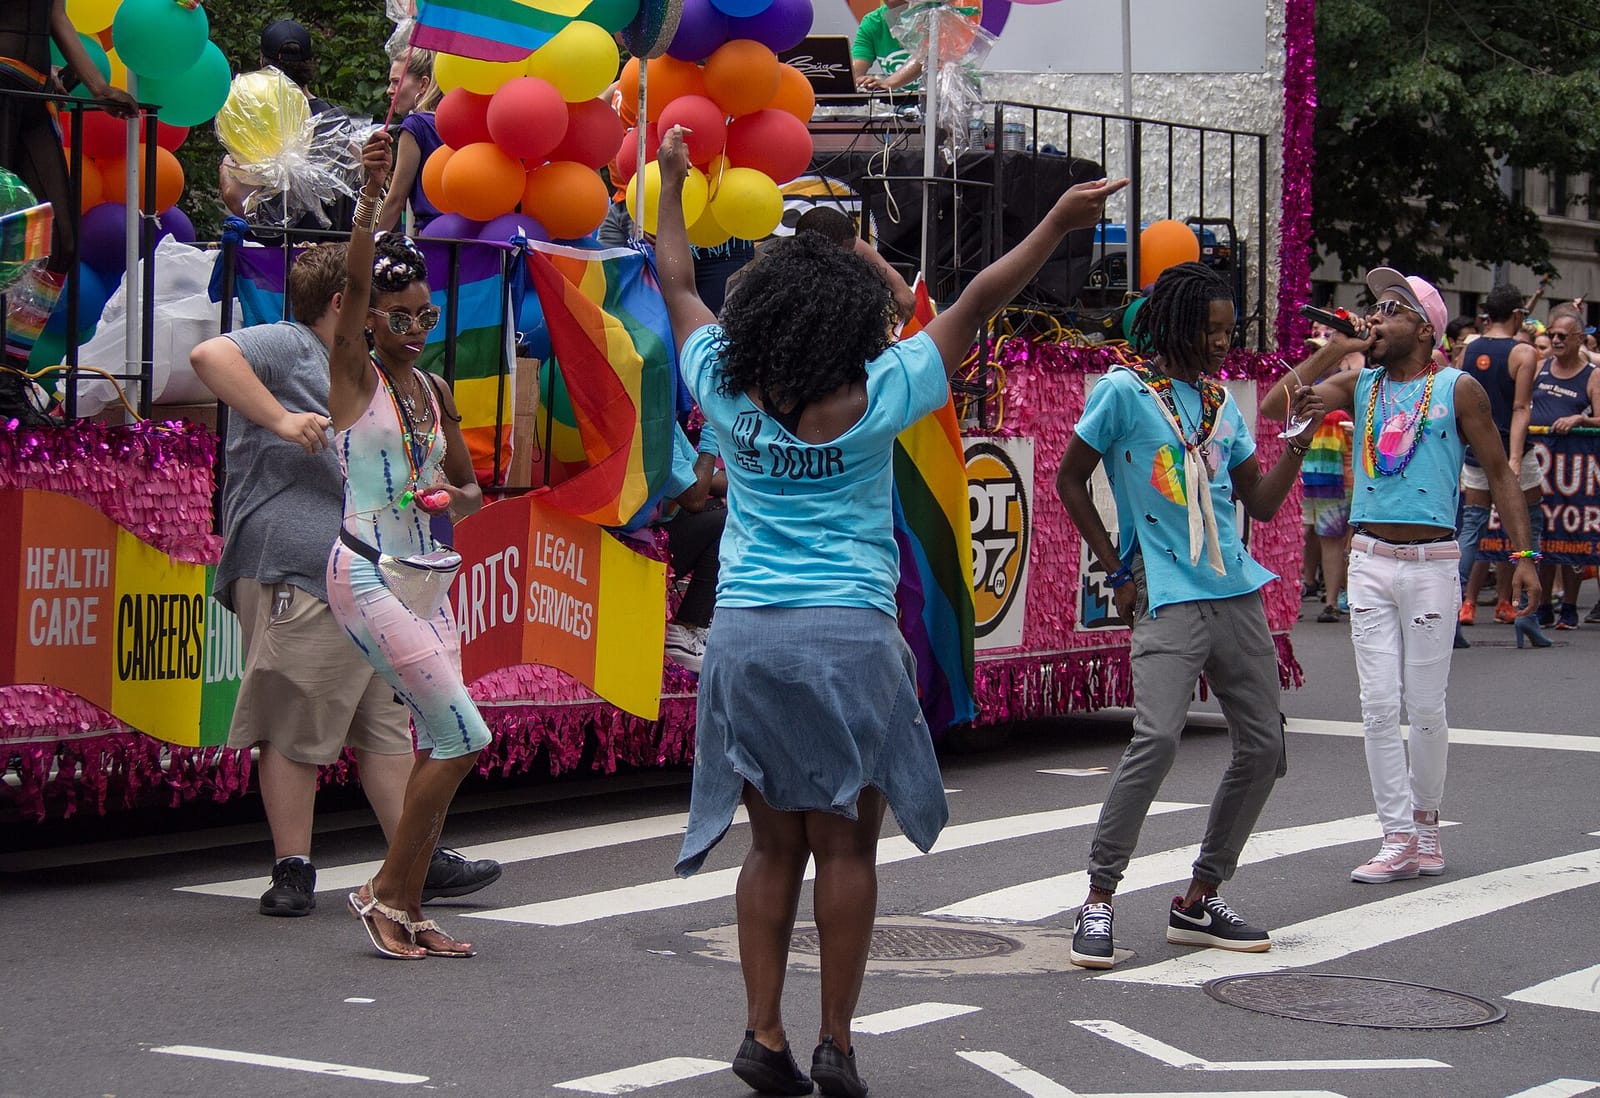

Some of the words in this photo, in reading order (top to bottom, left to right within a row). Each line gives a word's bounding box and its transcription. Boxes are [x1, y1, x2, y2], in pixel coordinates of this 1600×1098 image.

[768, 443, 844, 480] DOOR
[968, 483, 1015, 534] OT
[25, 546, 110, 590] HEALTH
[535, 531, 588, 586] LEGAL
[29, 596, 99, 647] CARE
[456, 545, 520, 645] ARTS
[526, 581, 593, 640] SERVICES
[117, 593, 204, 682] CAREERS
